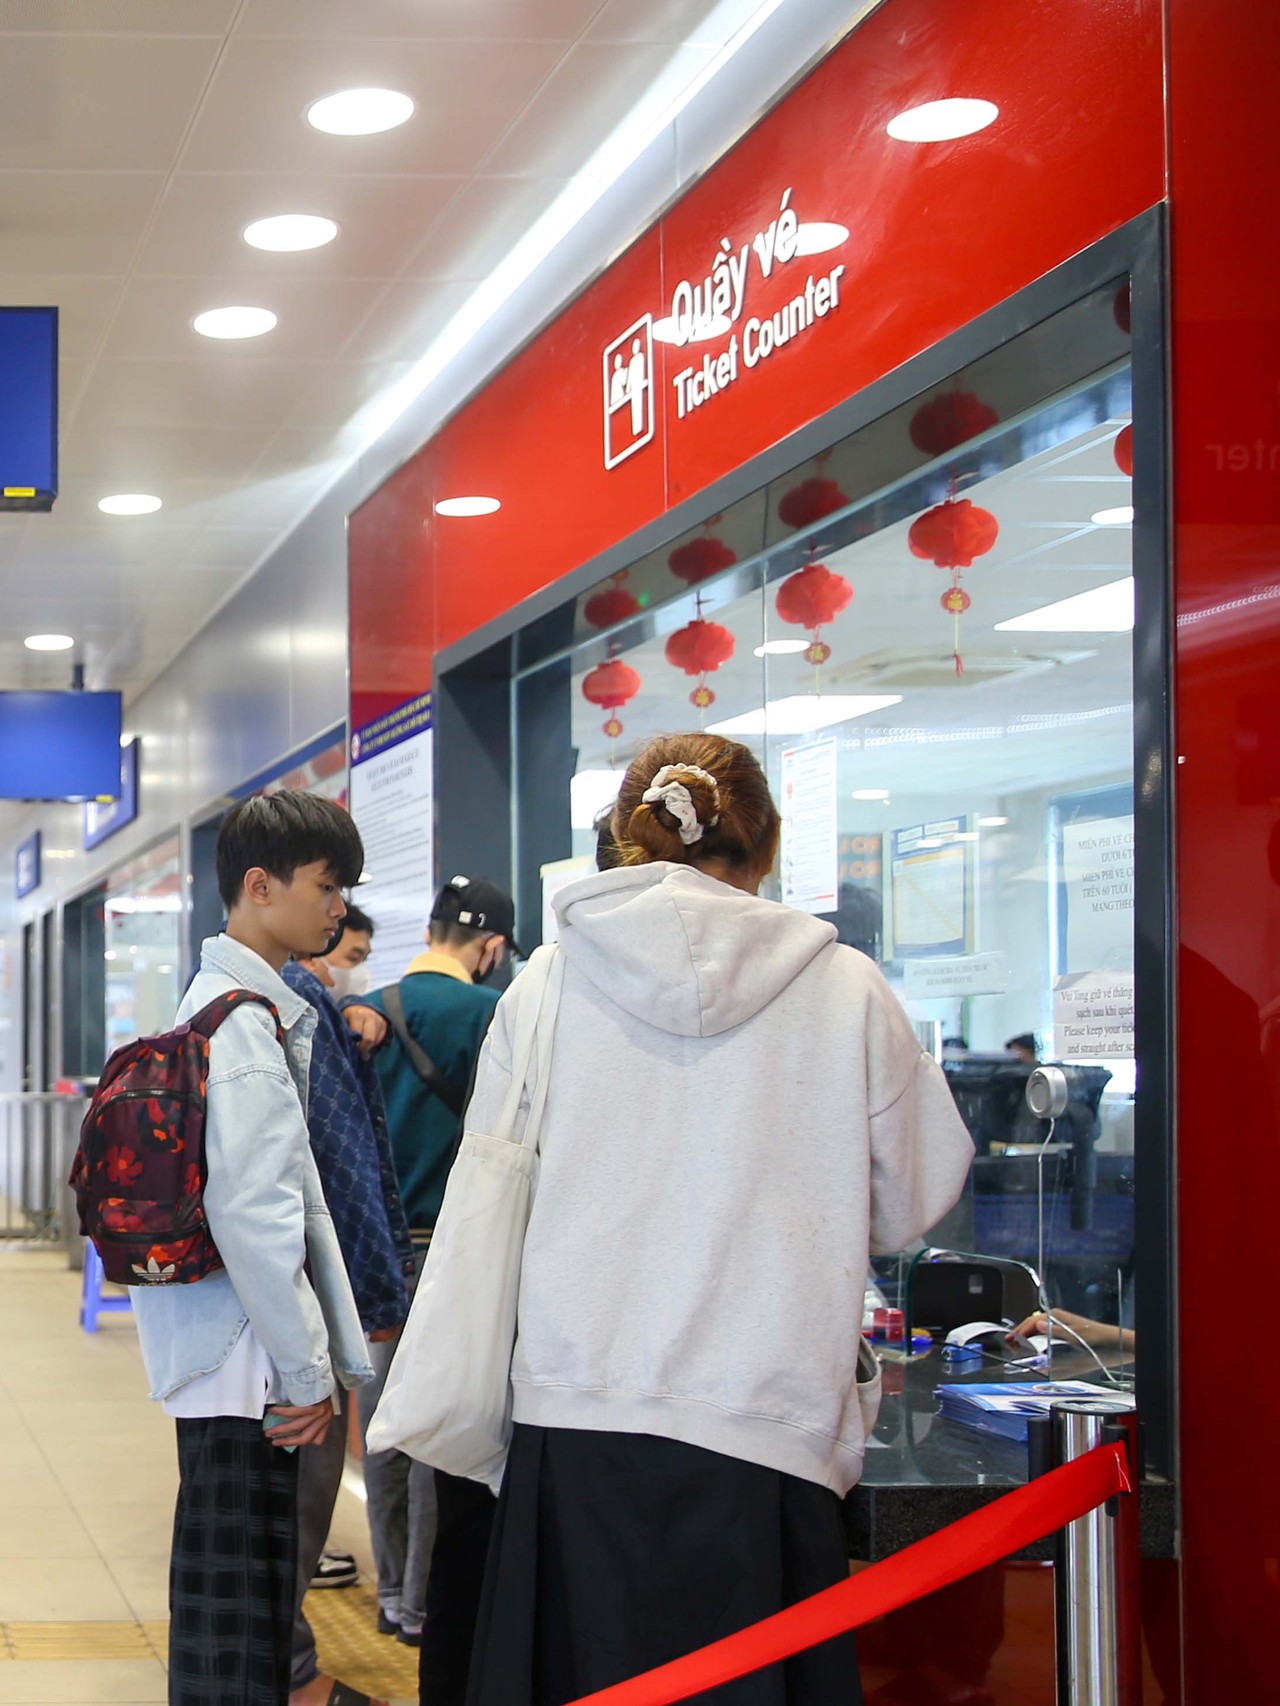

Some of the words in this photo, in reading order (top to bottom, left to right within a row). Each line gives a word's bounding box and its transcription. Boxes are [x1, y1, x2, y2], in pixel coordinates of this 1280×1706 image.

[671, 237, 749, 347] Quầy
[752, 187, 799, 278] vé
[673, 334, 738, 419] Ticket
[743, 264, 845, 368] Counter
